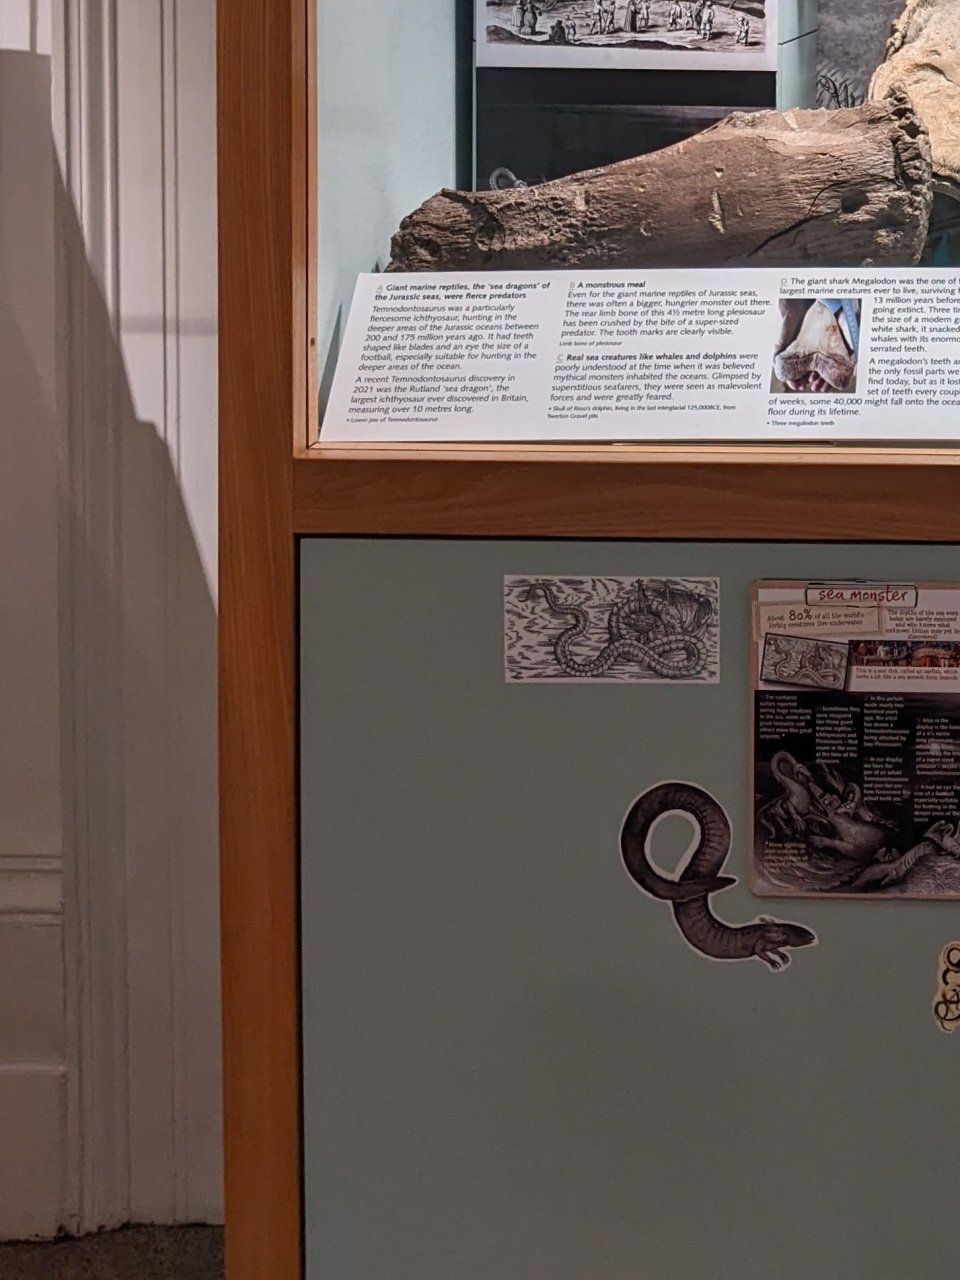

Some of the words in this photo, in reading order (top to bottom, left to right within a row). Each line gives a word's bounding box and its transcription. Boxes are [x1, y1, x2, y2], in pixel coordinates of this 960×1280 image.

[577, 281, 583, 289] A
[585, 280, 624, 289] monstrous
[627, 280, 645, 288] meal
[807, 277, 826, 286] giant
[851, 277, 896, 287] Megalodon
[916, 277, 928, 285] the
[947, 277, 956, 285] of
[386, 283, 408, 291] Giant
[409, 283, 436, 291] marine
[438, 283, 471, 293] reptiles,
[472, 282, 485, 290] the
[488, 282, 503, 290] 'sea
[505, 282, 539, 292] dragons'
[566, 353, 584, 361] Real
[655, 352, 683, 360] whales
[685, 352, 700, 360] and
[702, 352, 736, 362] dolphins
[819, 589, 844, 601] sea
[850, 585, 908, 602] monster
[788, 608, 813, 620] 80%
